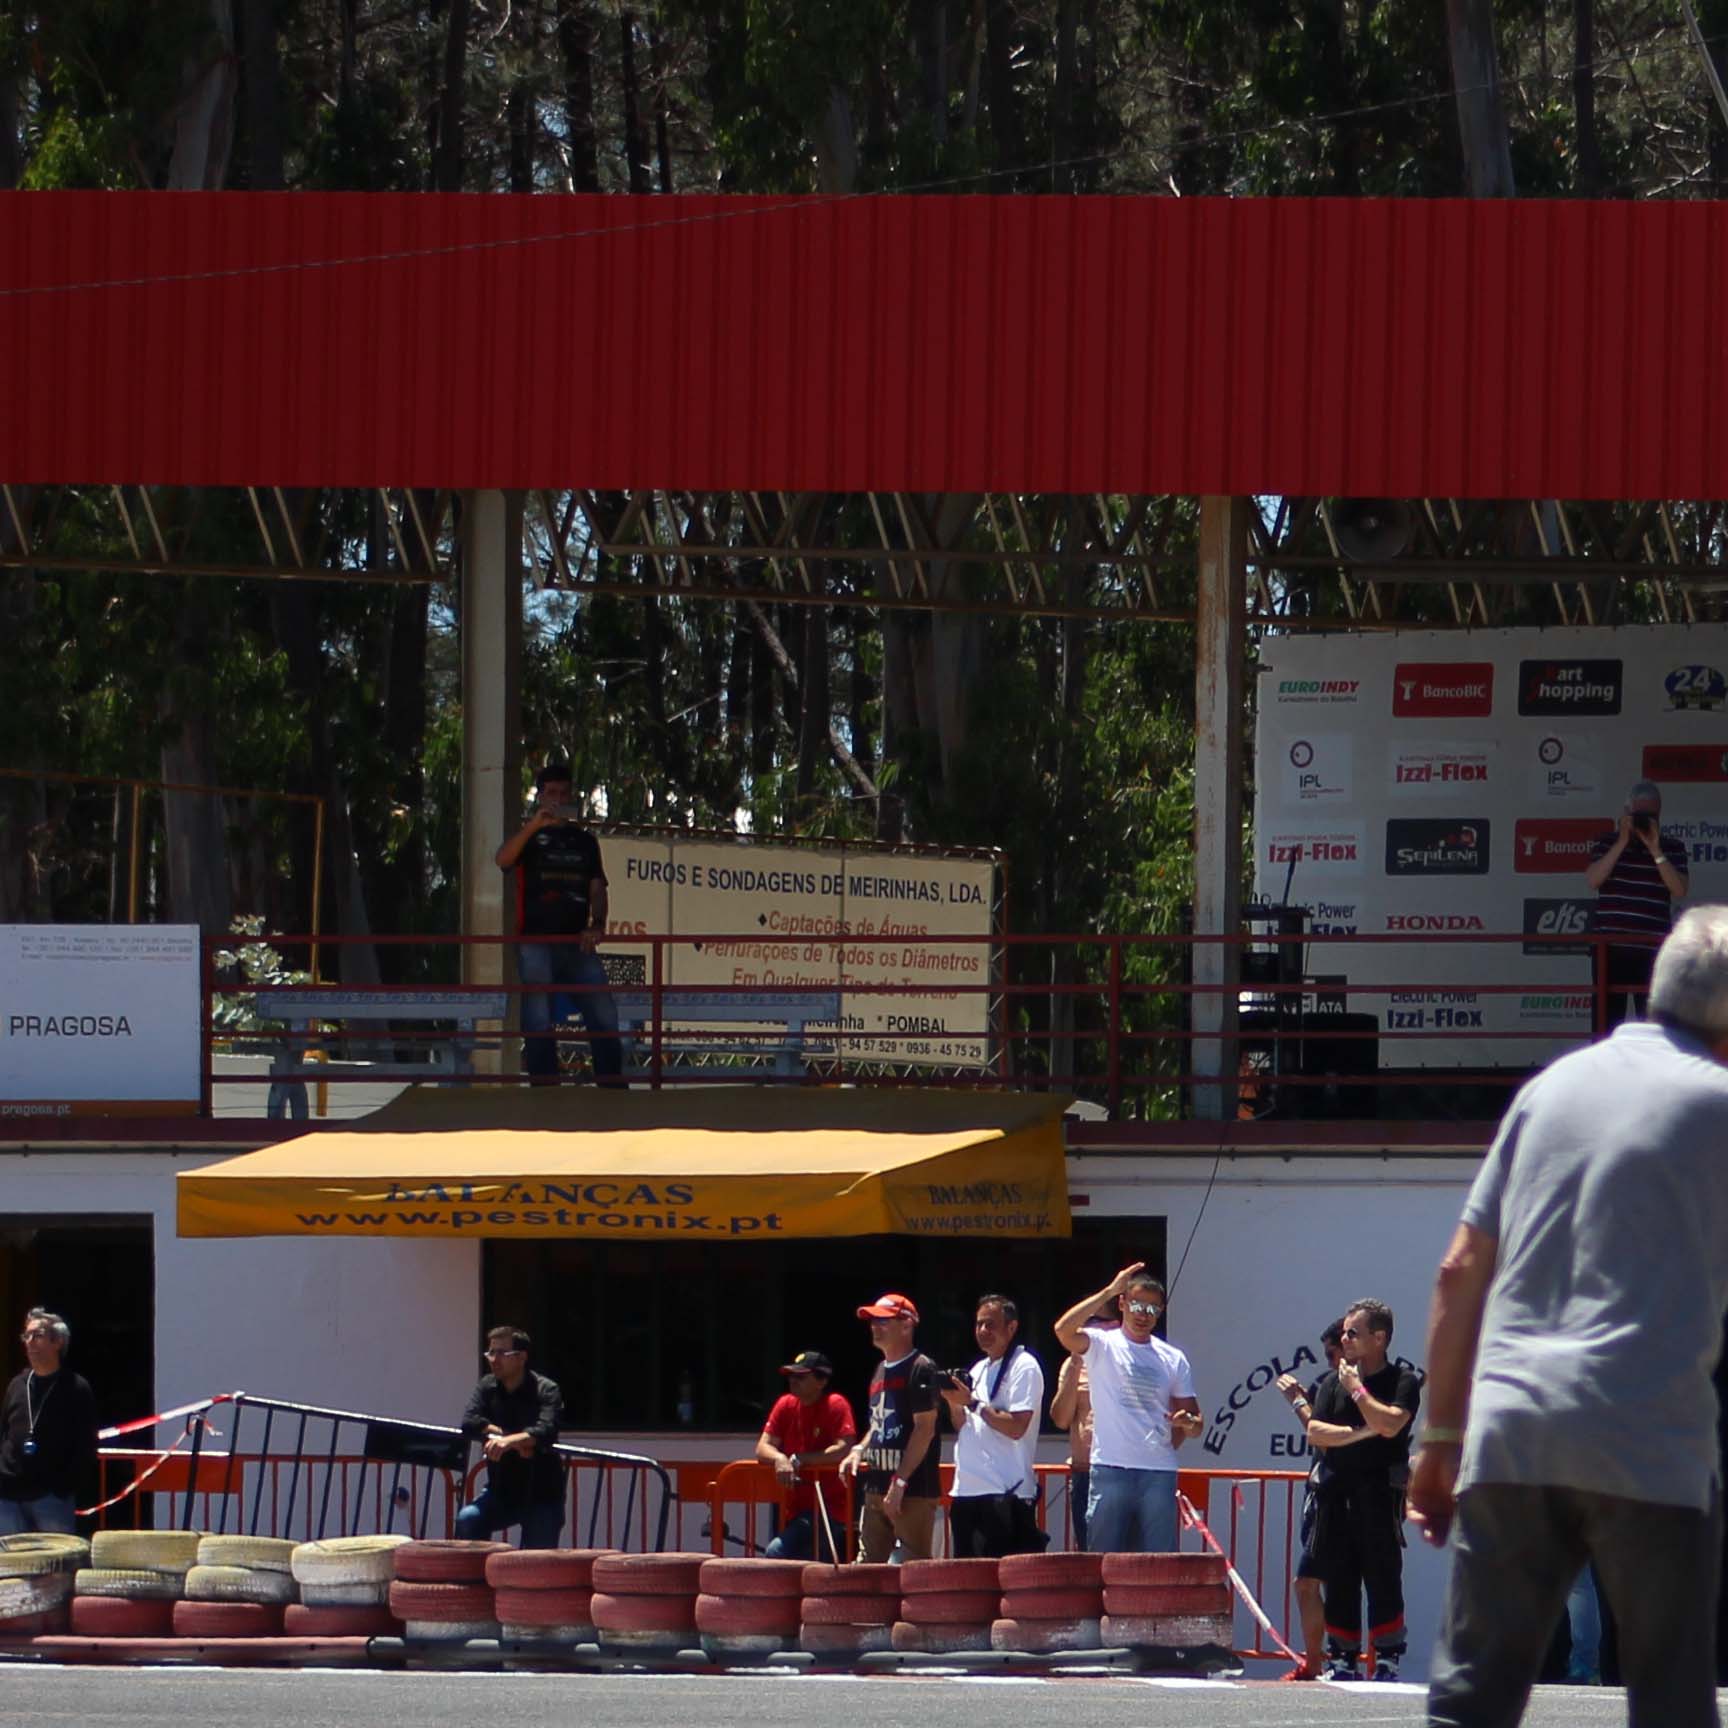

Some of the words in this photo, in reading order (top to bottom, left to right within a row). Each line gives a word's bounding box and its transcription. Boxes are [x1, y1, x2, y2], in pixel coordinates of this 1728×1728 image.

[1279, 680, 1360, 693] EUROINDY
[1675, 669, 1711, 691] 24
[1423, 684, 1487, 699] BancoBIC
[1299, 774, 1322, 788] IPL
[1396, 763, 1488, 783] Izzi-Flex
[1548, 771, 1571, 785] IPL
[1661, 821, 1697, 837] ectric
[1268, 843, 1357, 863] Izzi-Flex
[627, 859, 687, 885] FUROS
[692, 866, 702, 887] E
[708, 867, 816, 894] SONDAGENS
[821, 875, 843, 896] DE
[850, 875, 945, 905] MEIRINHAS,
[950, 883, 988, 905] LDA.
[1318, 902, 1357, 919] Power
[608, 920, 648, 935] ros
[769, 911, 851, 936] Captações
[857, 918, 874, 933] de
[880, 914, 927, 936] Águas
[1385, 914, 1486, 930] HONDA
[804, 944, 822, 962] de
[829, 944, 874, 966] Todos
[879, 950, 898, 967] os
[902, 948, 979, 972] Diâmetros
[733, 968, 757, 985] Em
[1520, 995, 1592, 1009] EUROIND
[10, 1016, 132, 1036] PRAGOSA
[888, 1016, 947, 1032] POMBAL
[1386, 1007, 1483, 1029] Izzi-Flex
[295, 1207, 783, 1234] www.pestronix.pt
[1203, 1345, 1318, 1456] ESCOLA
